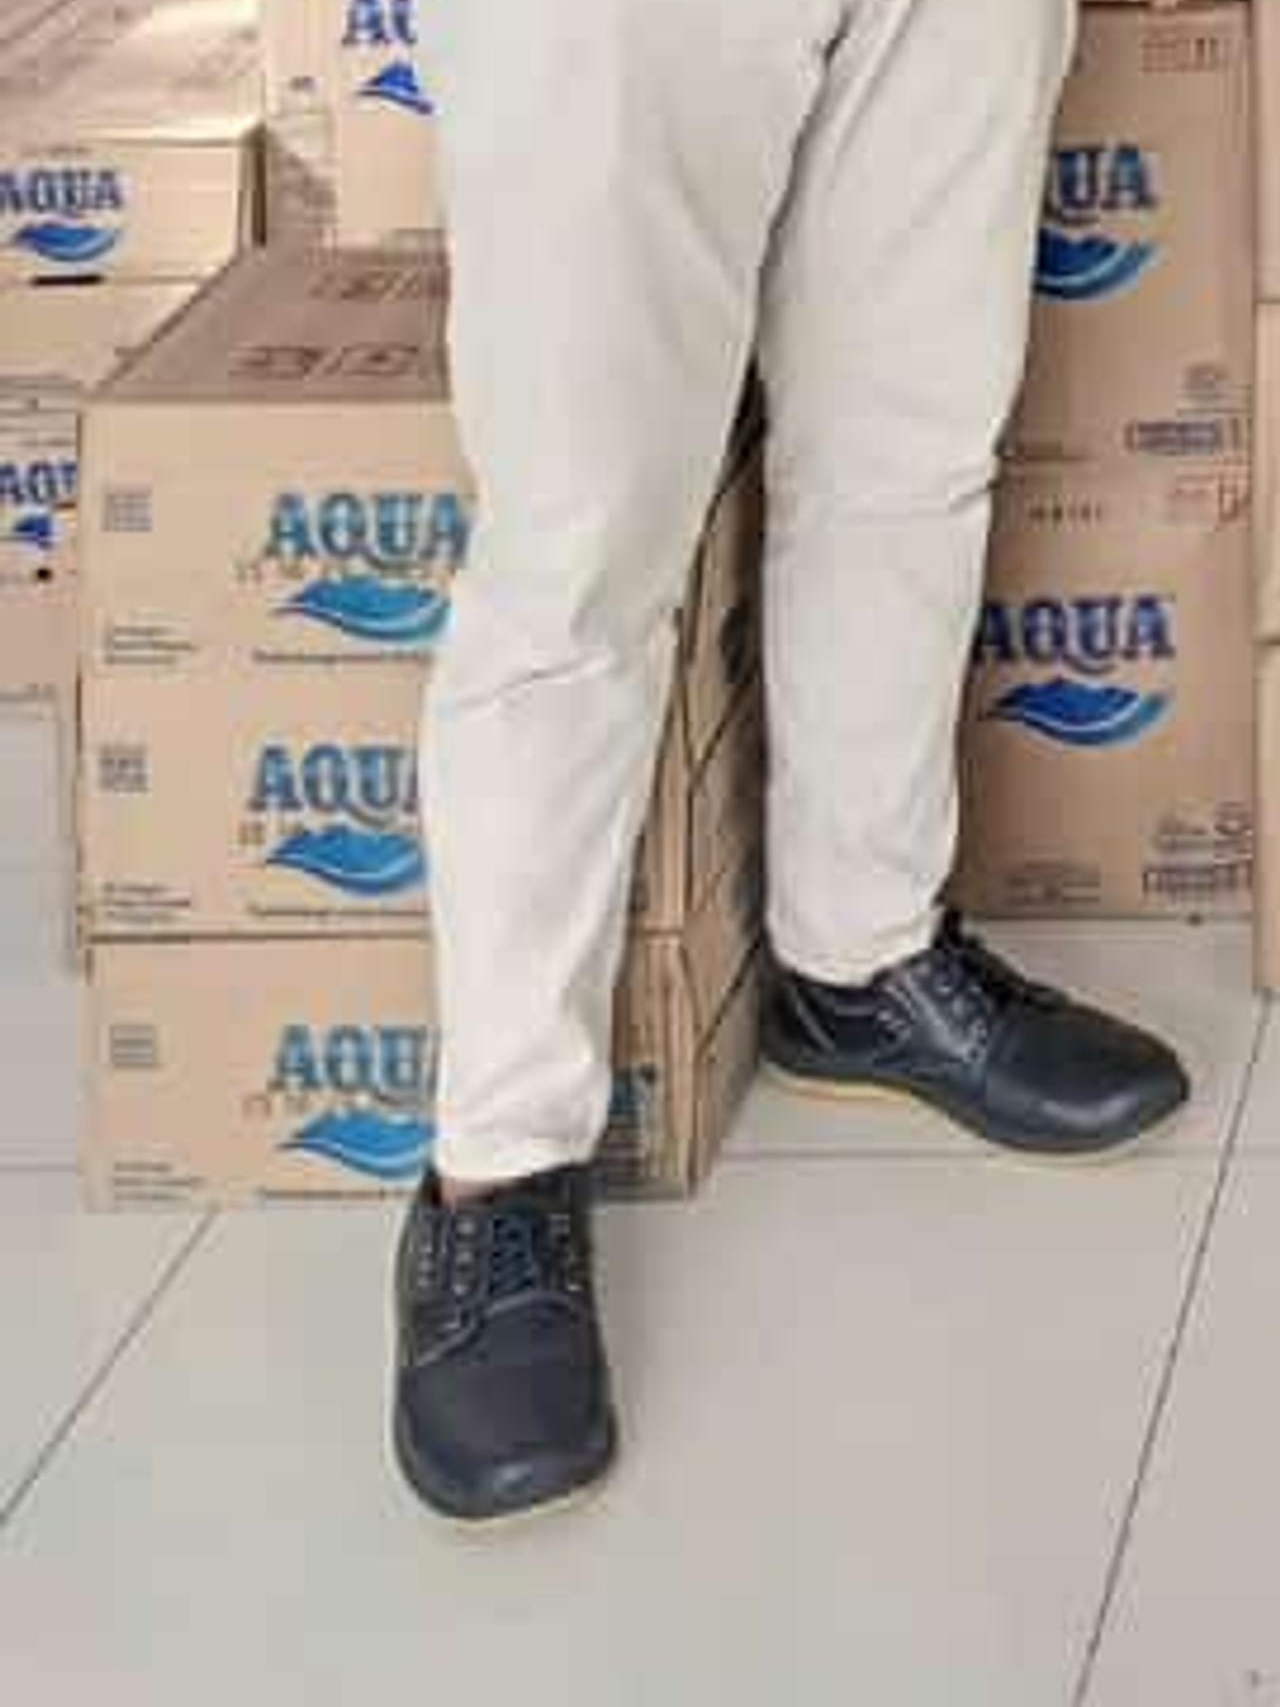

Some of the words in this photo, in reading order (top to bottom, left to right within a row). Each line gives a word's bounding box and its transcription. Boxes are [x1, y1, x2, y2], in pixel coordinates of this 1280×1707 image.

[265, 492, 468, 573] AQUA
[975, 593, 1175, 676] AQUA
[268, 1024, 438, 1107] AQU
